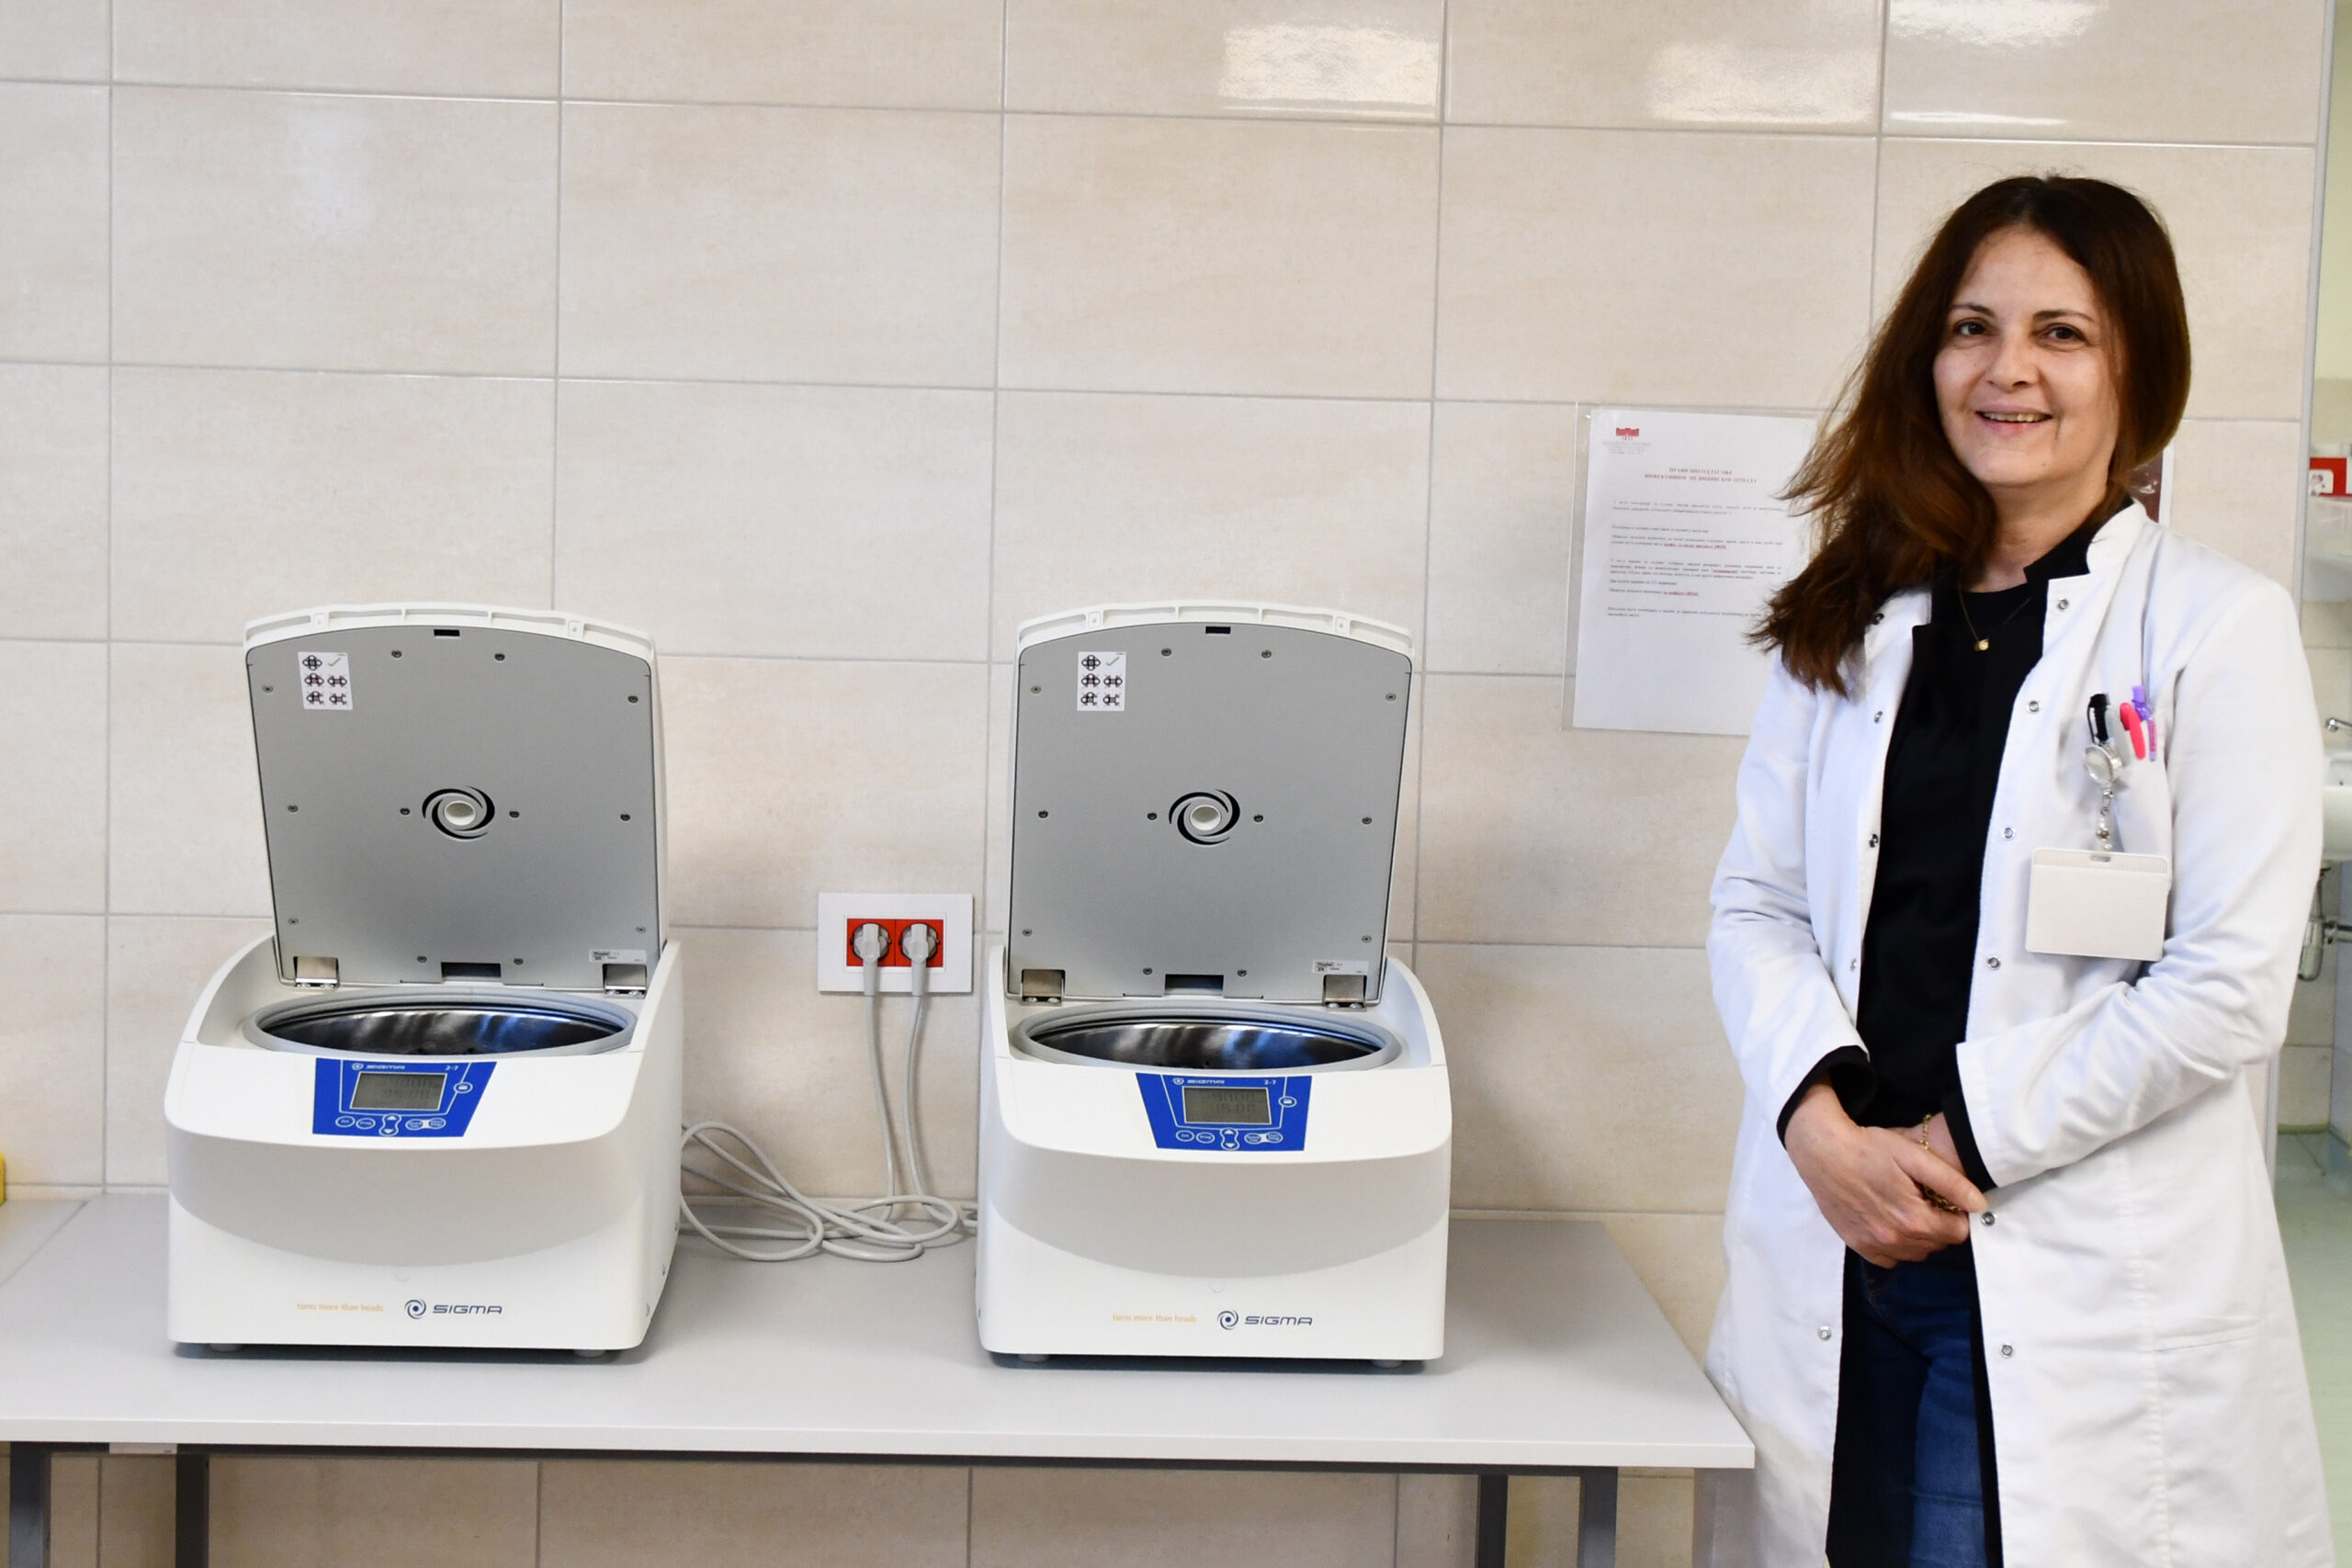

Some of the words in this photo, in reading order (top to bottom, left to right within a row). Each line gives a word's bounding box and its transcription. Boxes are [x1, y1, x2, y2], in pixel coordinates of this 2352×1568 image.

[297, 1303, 317, 1311] turns
[319, 1303, 339, 1312] more
[341, 1303, 359, 1312] than
[360, 1303, 384, 1313] heads
[433, 1304, 503, 1314] SIGMA
[1156, 1314, 1173, 1323] than
[1174, 1314, 1197, 1324] heads
[1244, 1315, 1313, 1325] SIGMA
